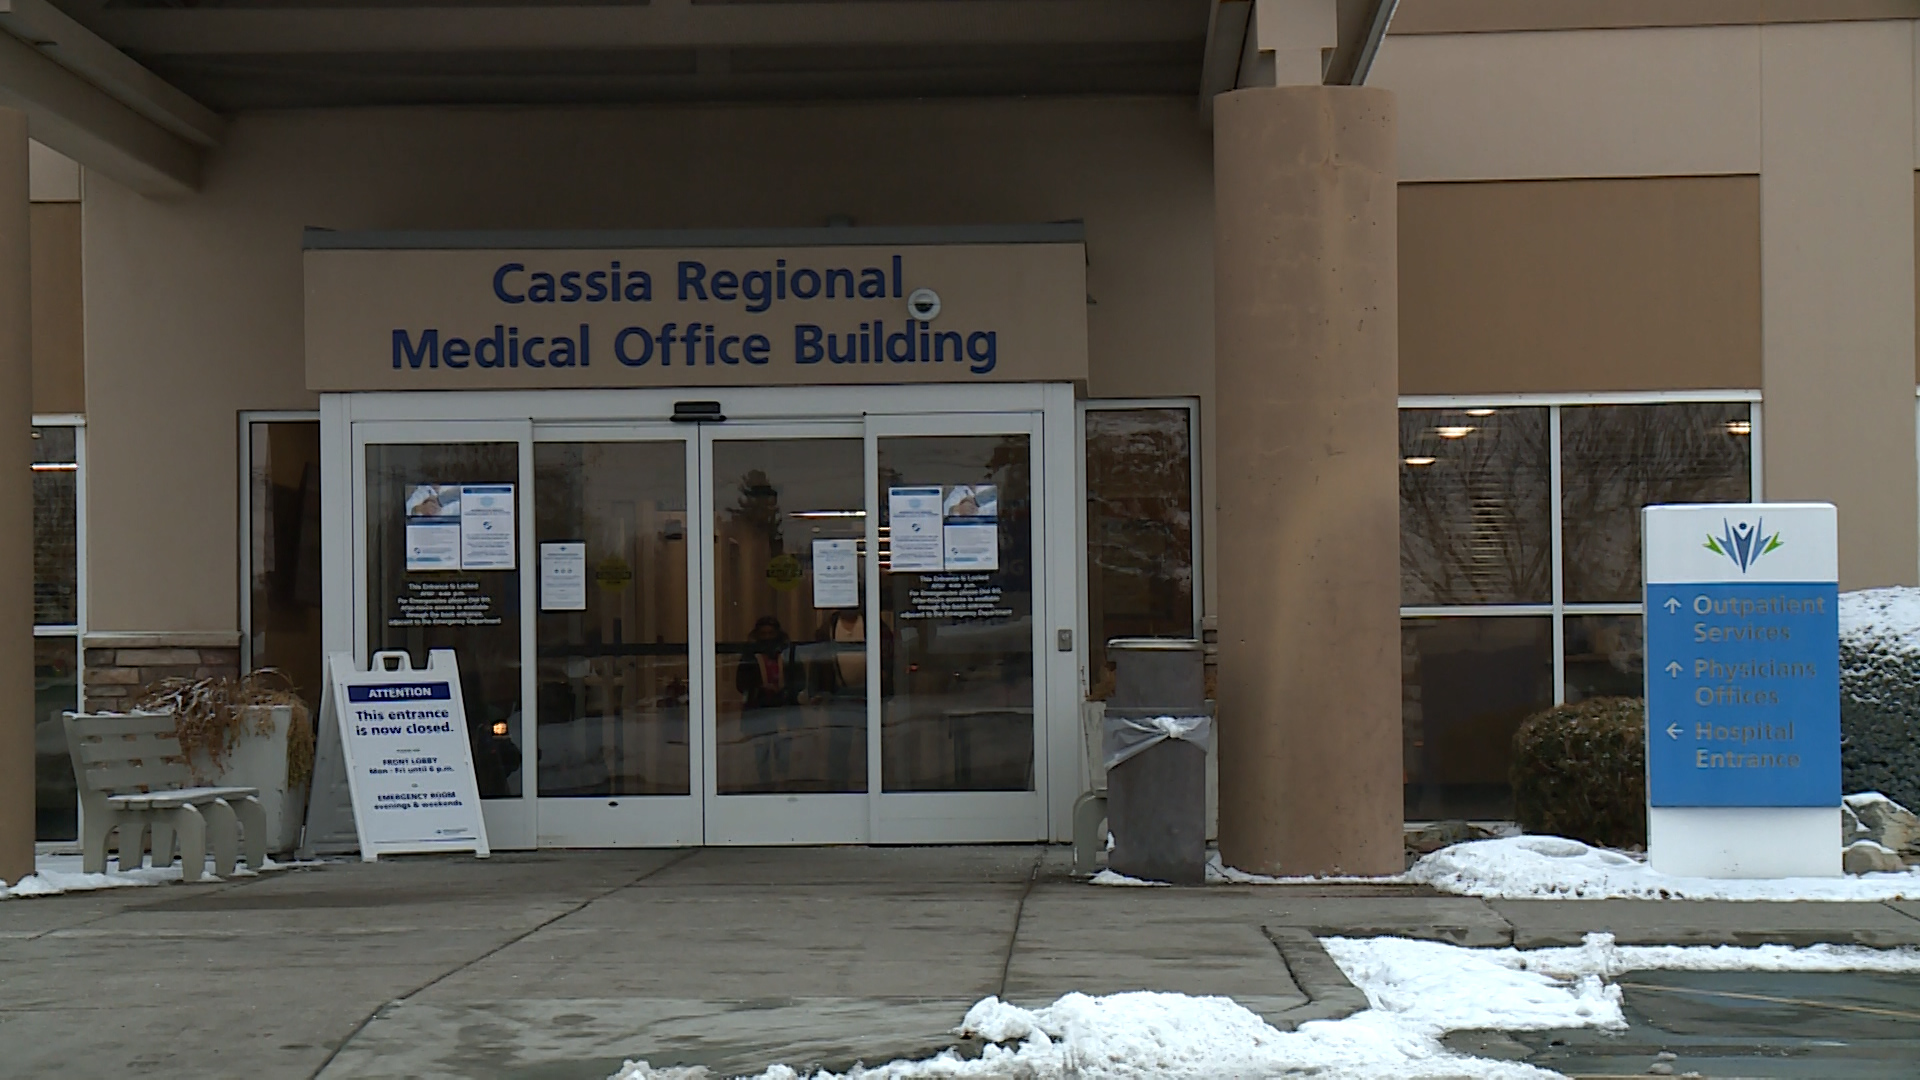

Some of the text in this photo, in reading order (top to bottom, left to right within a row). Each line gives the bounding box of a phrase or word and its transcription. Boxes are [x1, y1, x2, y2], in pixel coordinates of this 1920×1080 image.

[493, 255, 903, 313] Cassia Regional
[391, 318, 997, 374] Medical Office Building
[1693, 594, 1826, 619] Outpatient
[1694, 621, 1791, 643] Services
[1694, 658, 1817, 683] Physicians
[368, 686, 432, 699] ATTENTION
[1695, 685, 1779, 706] Offices
[355, 708, 449, 721] This entrance
[355, 721, 454, 736] is now closed.
[1695, 720, 1795, 746] Hospital
[382, 757, 438, 766] FRONT LOBBY
[1695, 748, 1800, 769] Entrance
[369, 767, 388, 775] Mon
[374, 802, 412, 810] evenings
[421, 800, 463, 808] weekends
[377, 791, 456, 801] EMERGENCY ROOM
